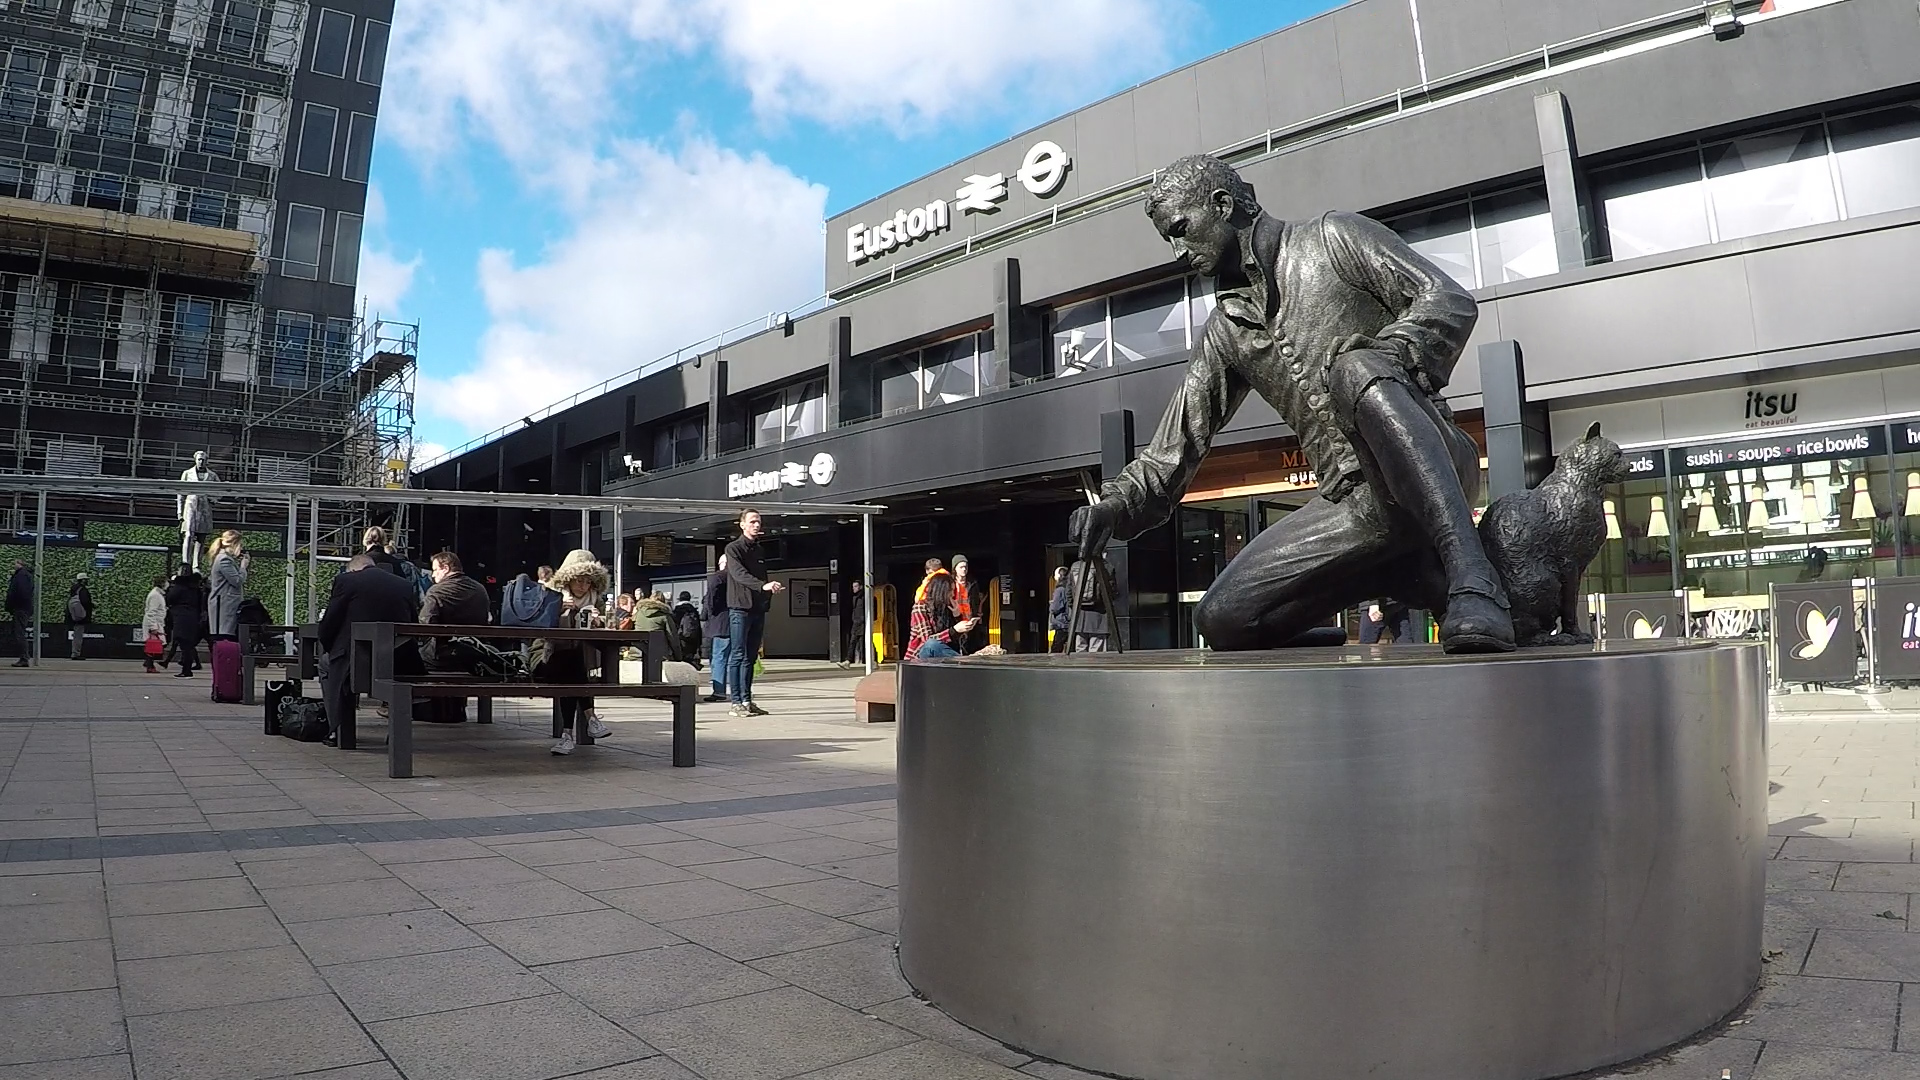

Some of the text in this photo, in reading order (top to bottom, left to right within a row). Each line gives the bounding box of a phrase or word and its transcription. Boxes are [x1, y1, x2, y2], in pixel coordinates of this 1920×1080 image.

[847, 199, 948, 263] Euston
[1745, 391, 1797, 418] itsu
[1761, 416, 1798, 427] beautiful
[1906, 428, 1920, 444] h
[1686, 434, 1870, 467] sushi soups rice bowls
[728, 470, 782, 498] Euston
[1902, 640, 1920, 649] eat
